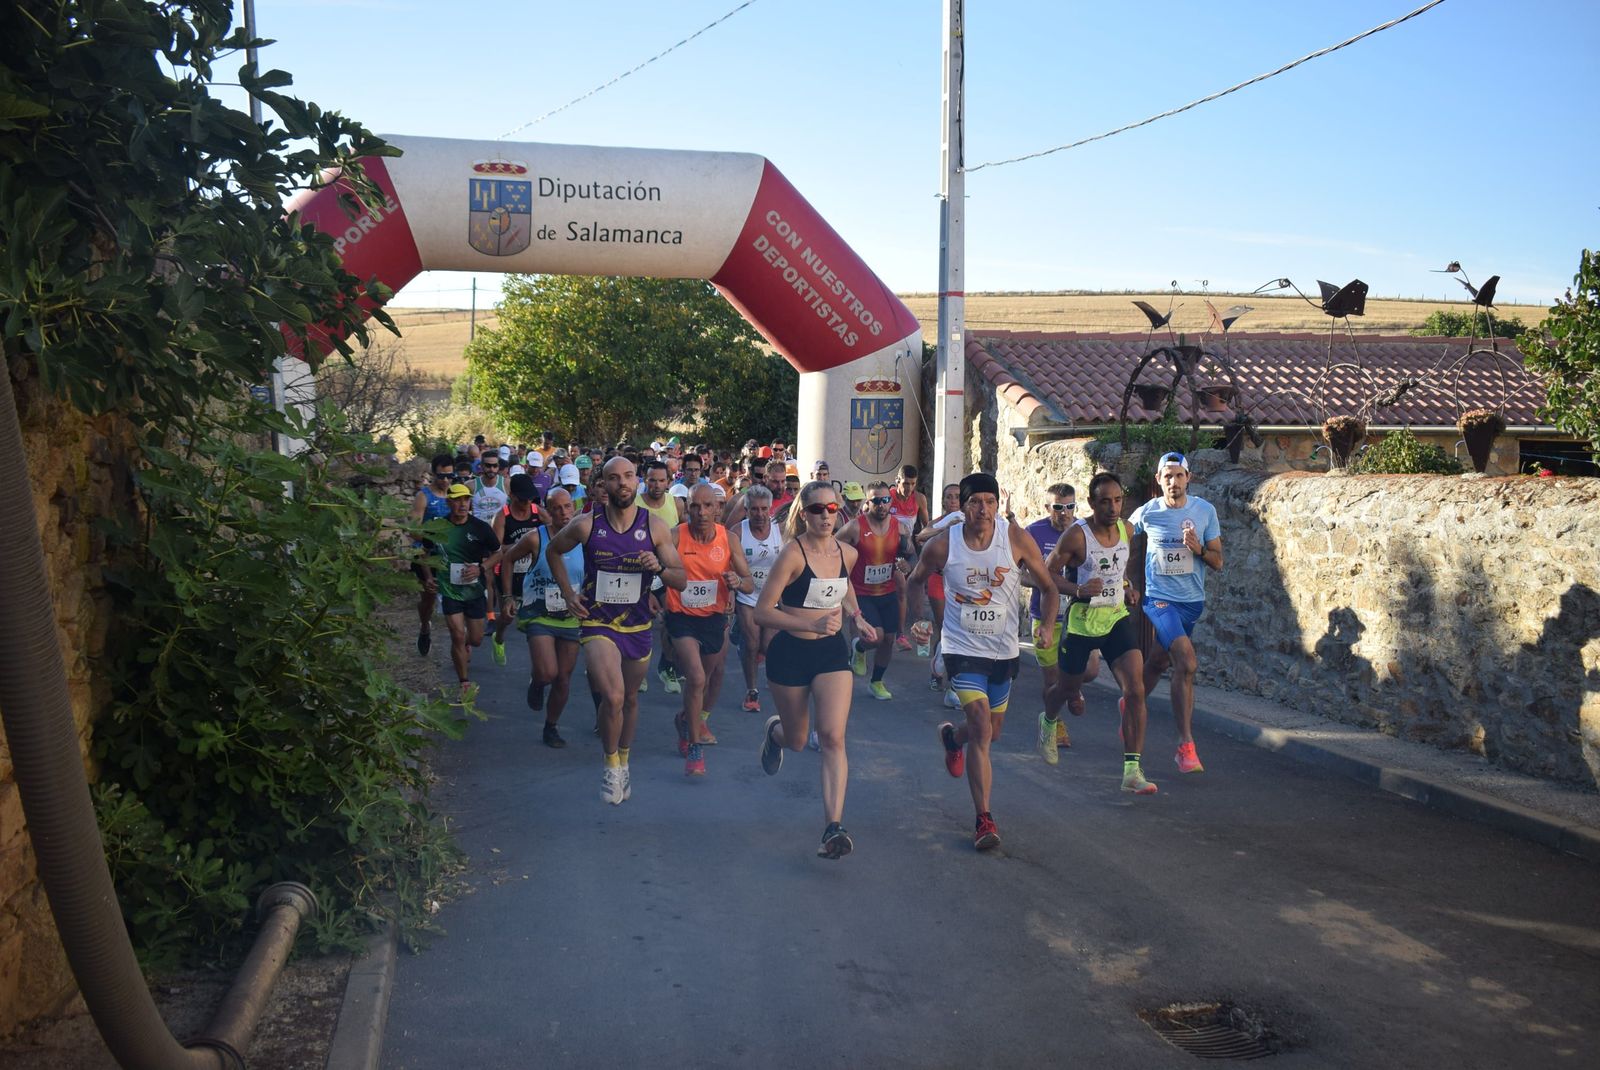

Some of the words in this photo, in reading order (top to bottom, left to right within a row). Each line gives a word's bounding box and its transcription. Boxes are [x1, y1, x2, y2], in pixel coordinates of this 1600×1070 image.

[538, 177, 661, 203] Diputación
[536, 224, 557, 241] de
[566, 221, 683, 245] Salamanca
[765, 209, 803, 250] CON
[800, 246, 884, 336] NUESTROS
[752, 234, 859, 347] DEPORTISTAS
[1166, 552, 1181, 563] 64
[752, 571, 764, 579] 42
[871, 567, 887, 576] 110
[615, 577, 622, 588] 1
[692, 586, 707, 596] 36
[825, 585, 834, 597] 2
[1101, 587, 1116, 598] 63
[971, 609, 996, 622] 103
